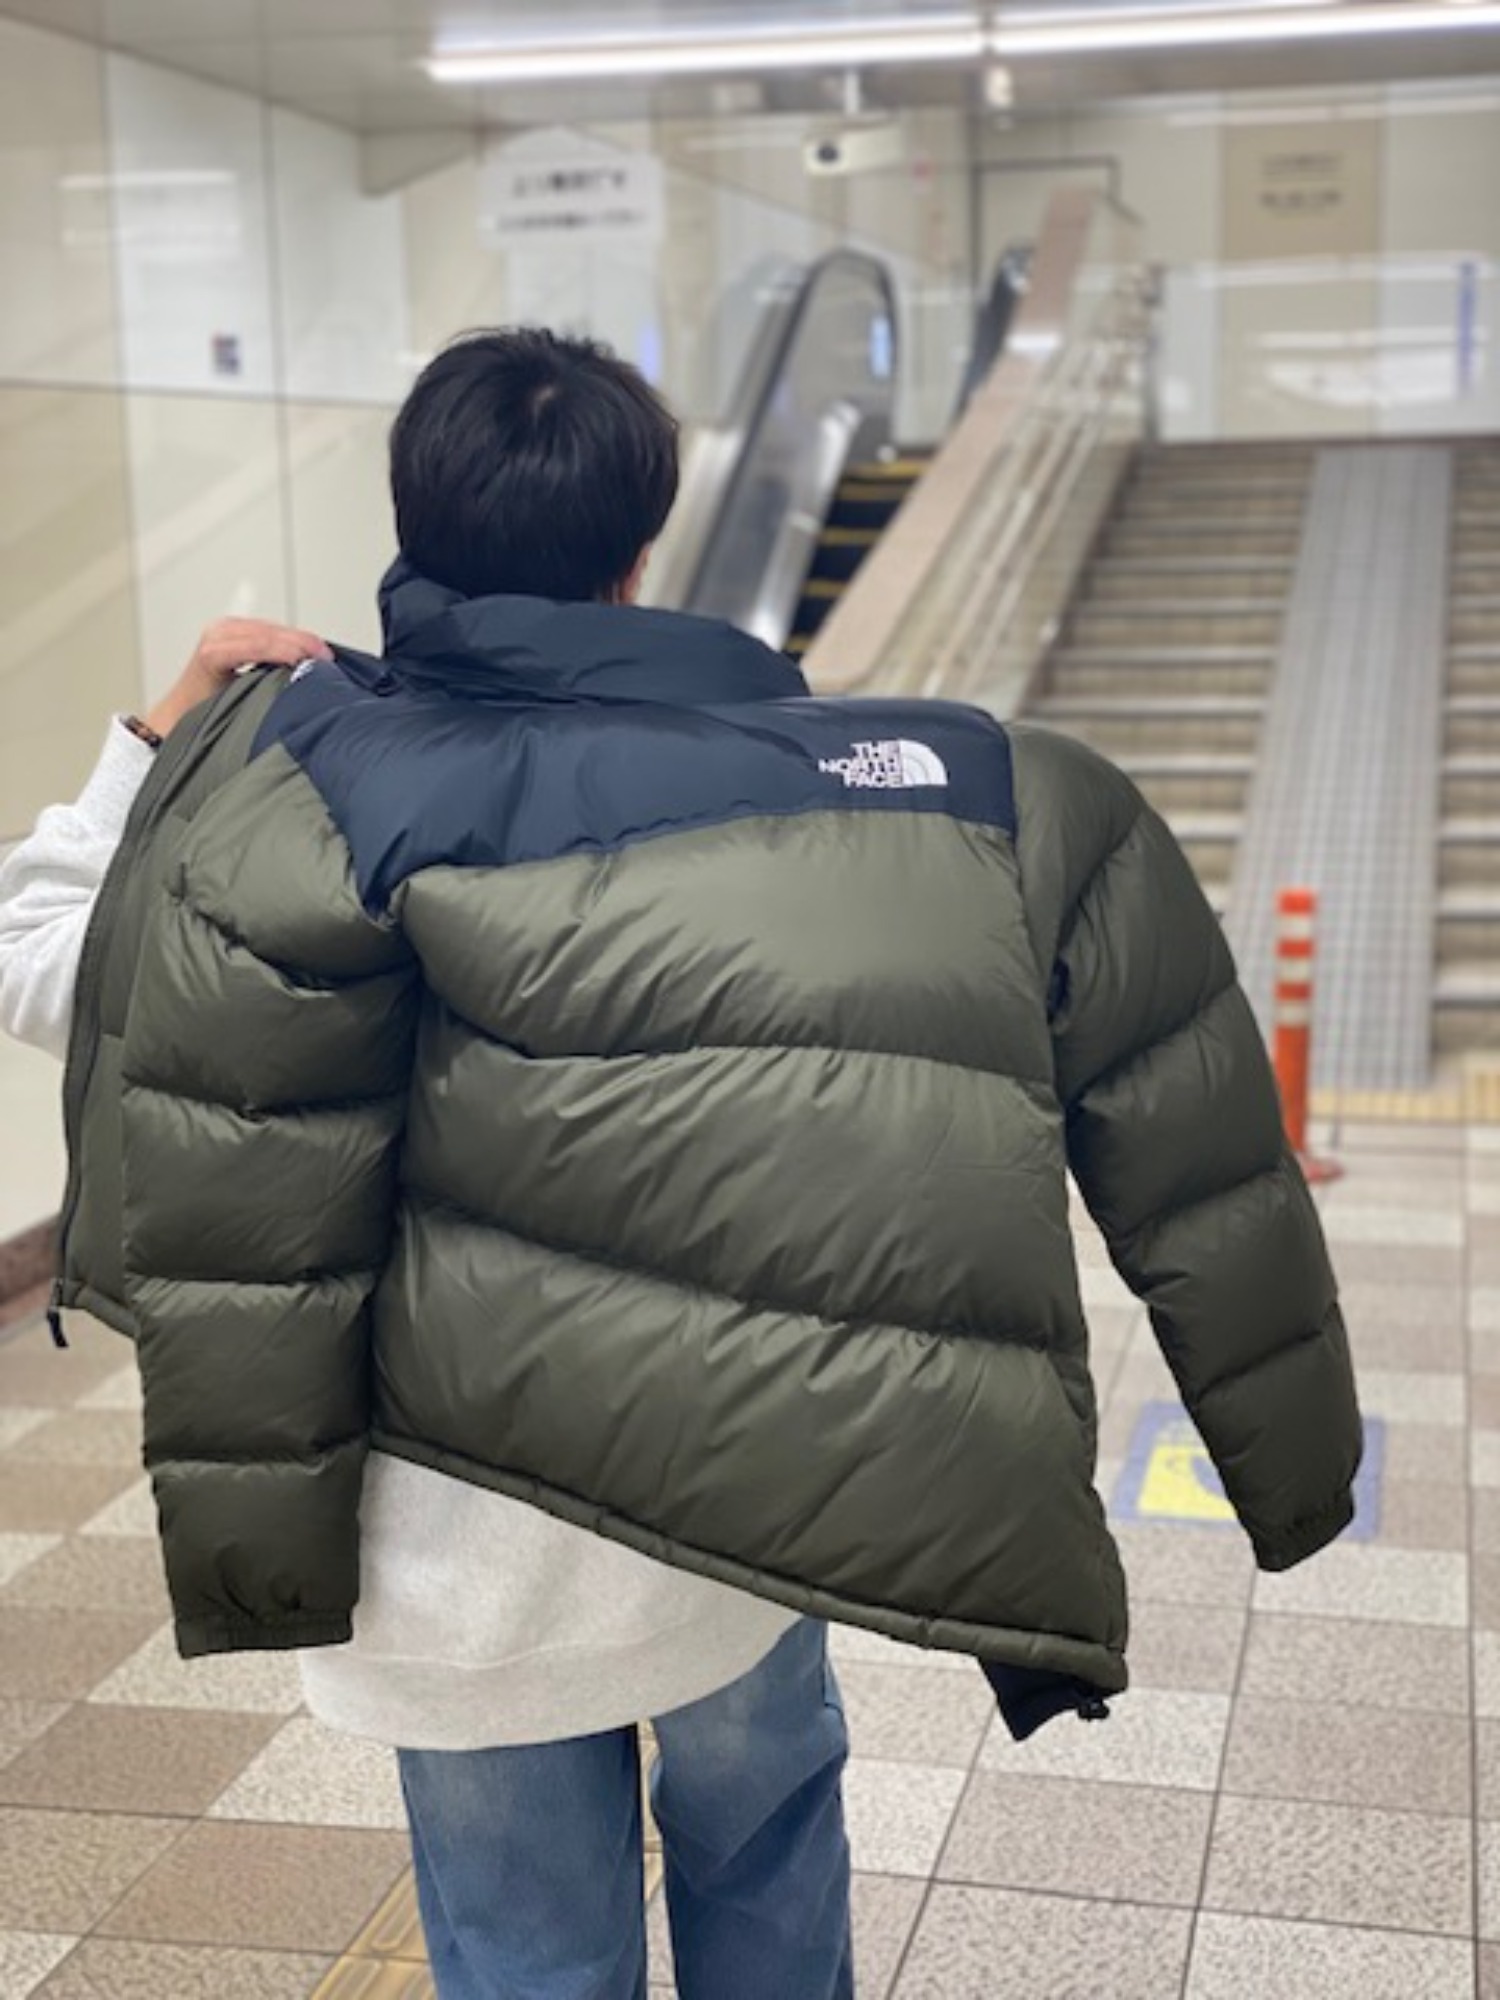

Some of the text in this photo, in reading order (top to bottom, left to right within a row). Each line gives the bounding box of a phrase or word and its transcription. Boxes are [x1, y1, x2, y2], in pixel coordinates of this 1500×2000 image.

[851, 741, 900, 758] THE
[818, 757, 901, 773] NORTH
[844, 773, 903, 788] FACE
